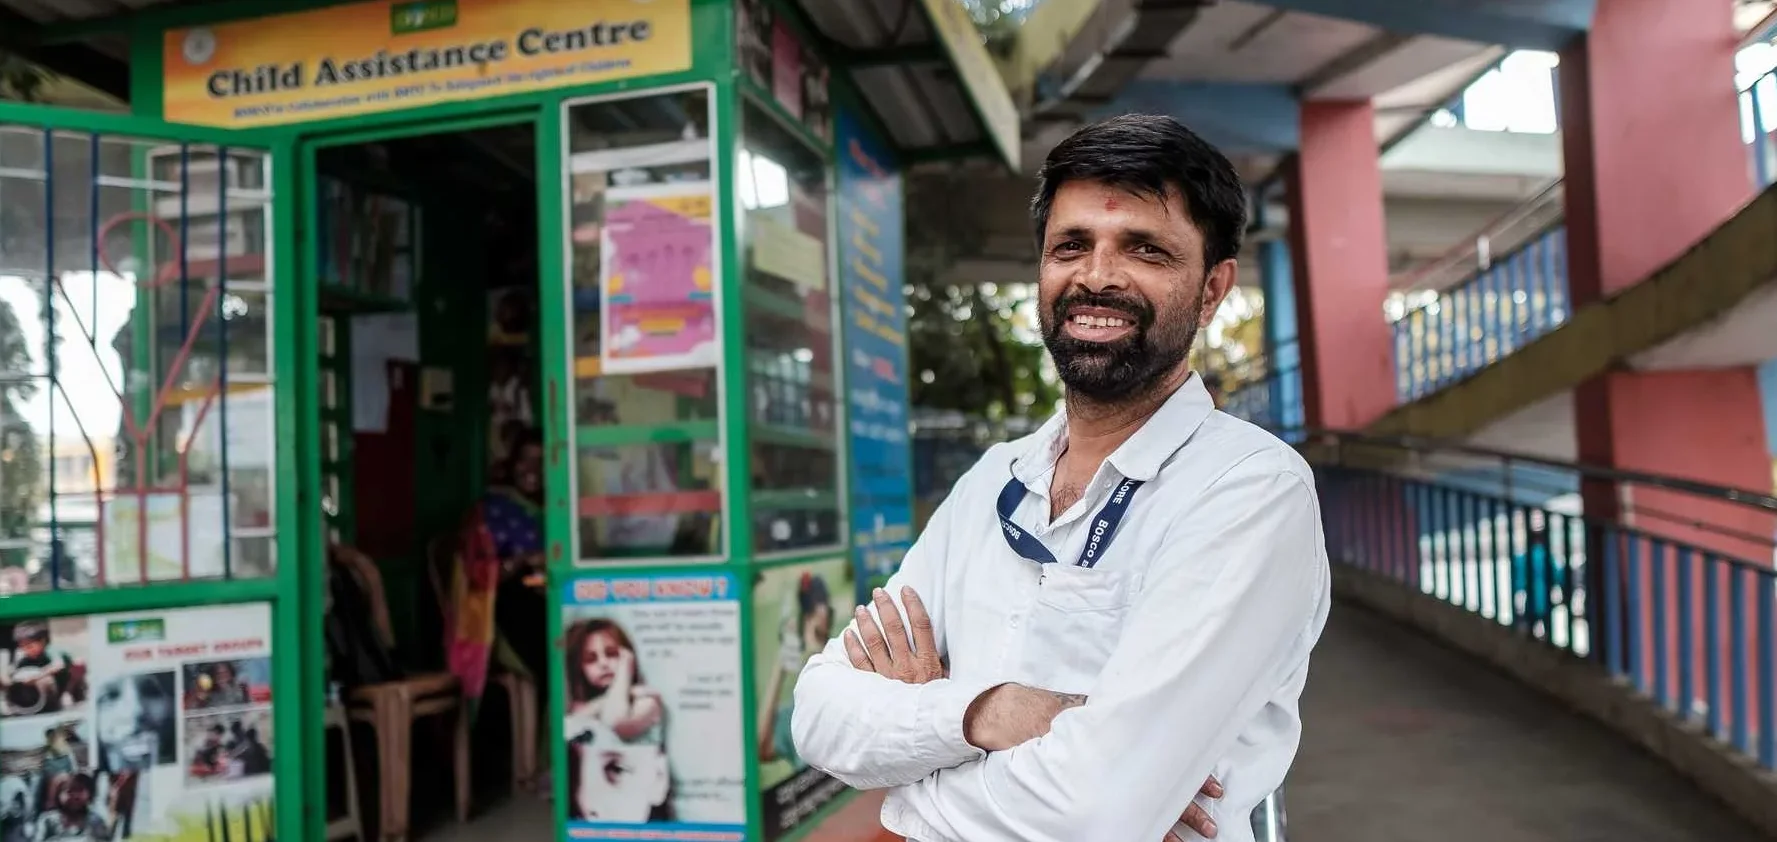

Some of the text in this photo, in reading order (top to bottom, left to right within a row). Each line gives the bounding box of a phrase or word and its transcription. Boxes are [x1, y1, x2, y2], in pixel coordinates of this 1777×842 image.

[207, 19, 650, 98] Child Assistance Centre
[1086, 519, 1109, 558] BOSCO
